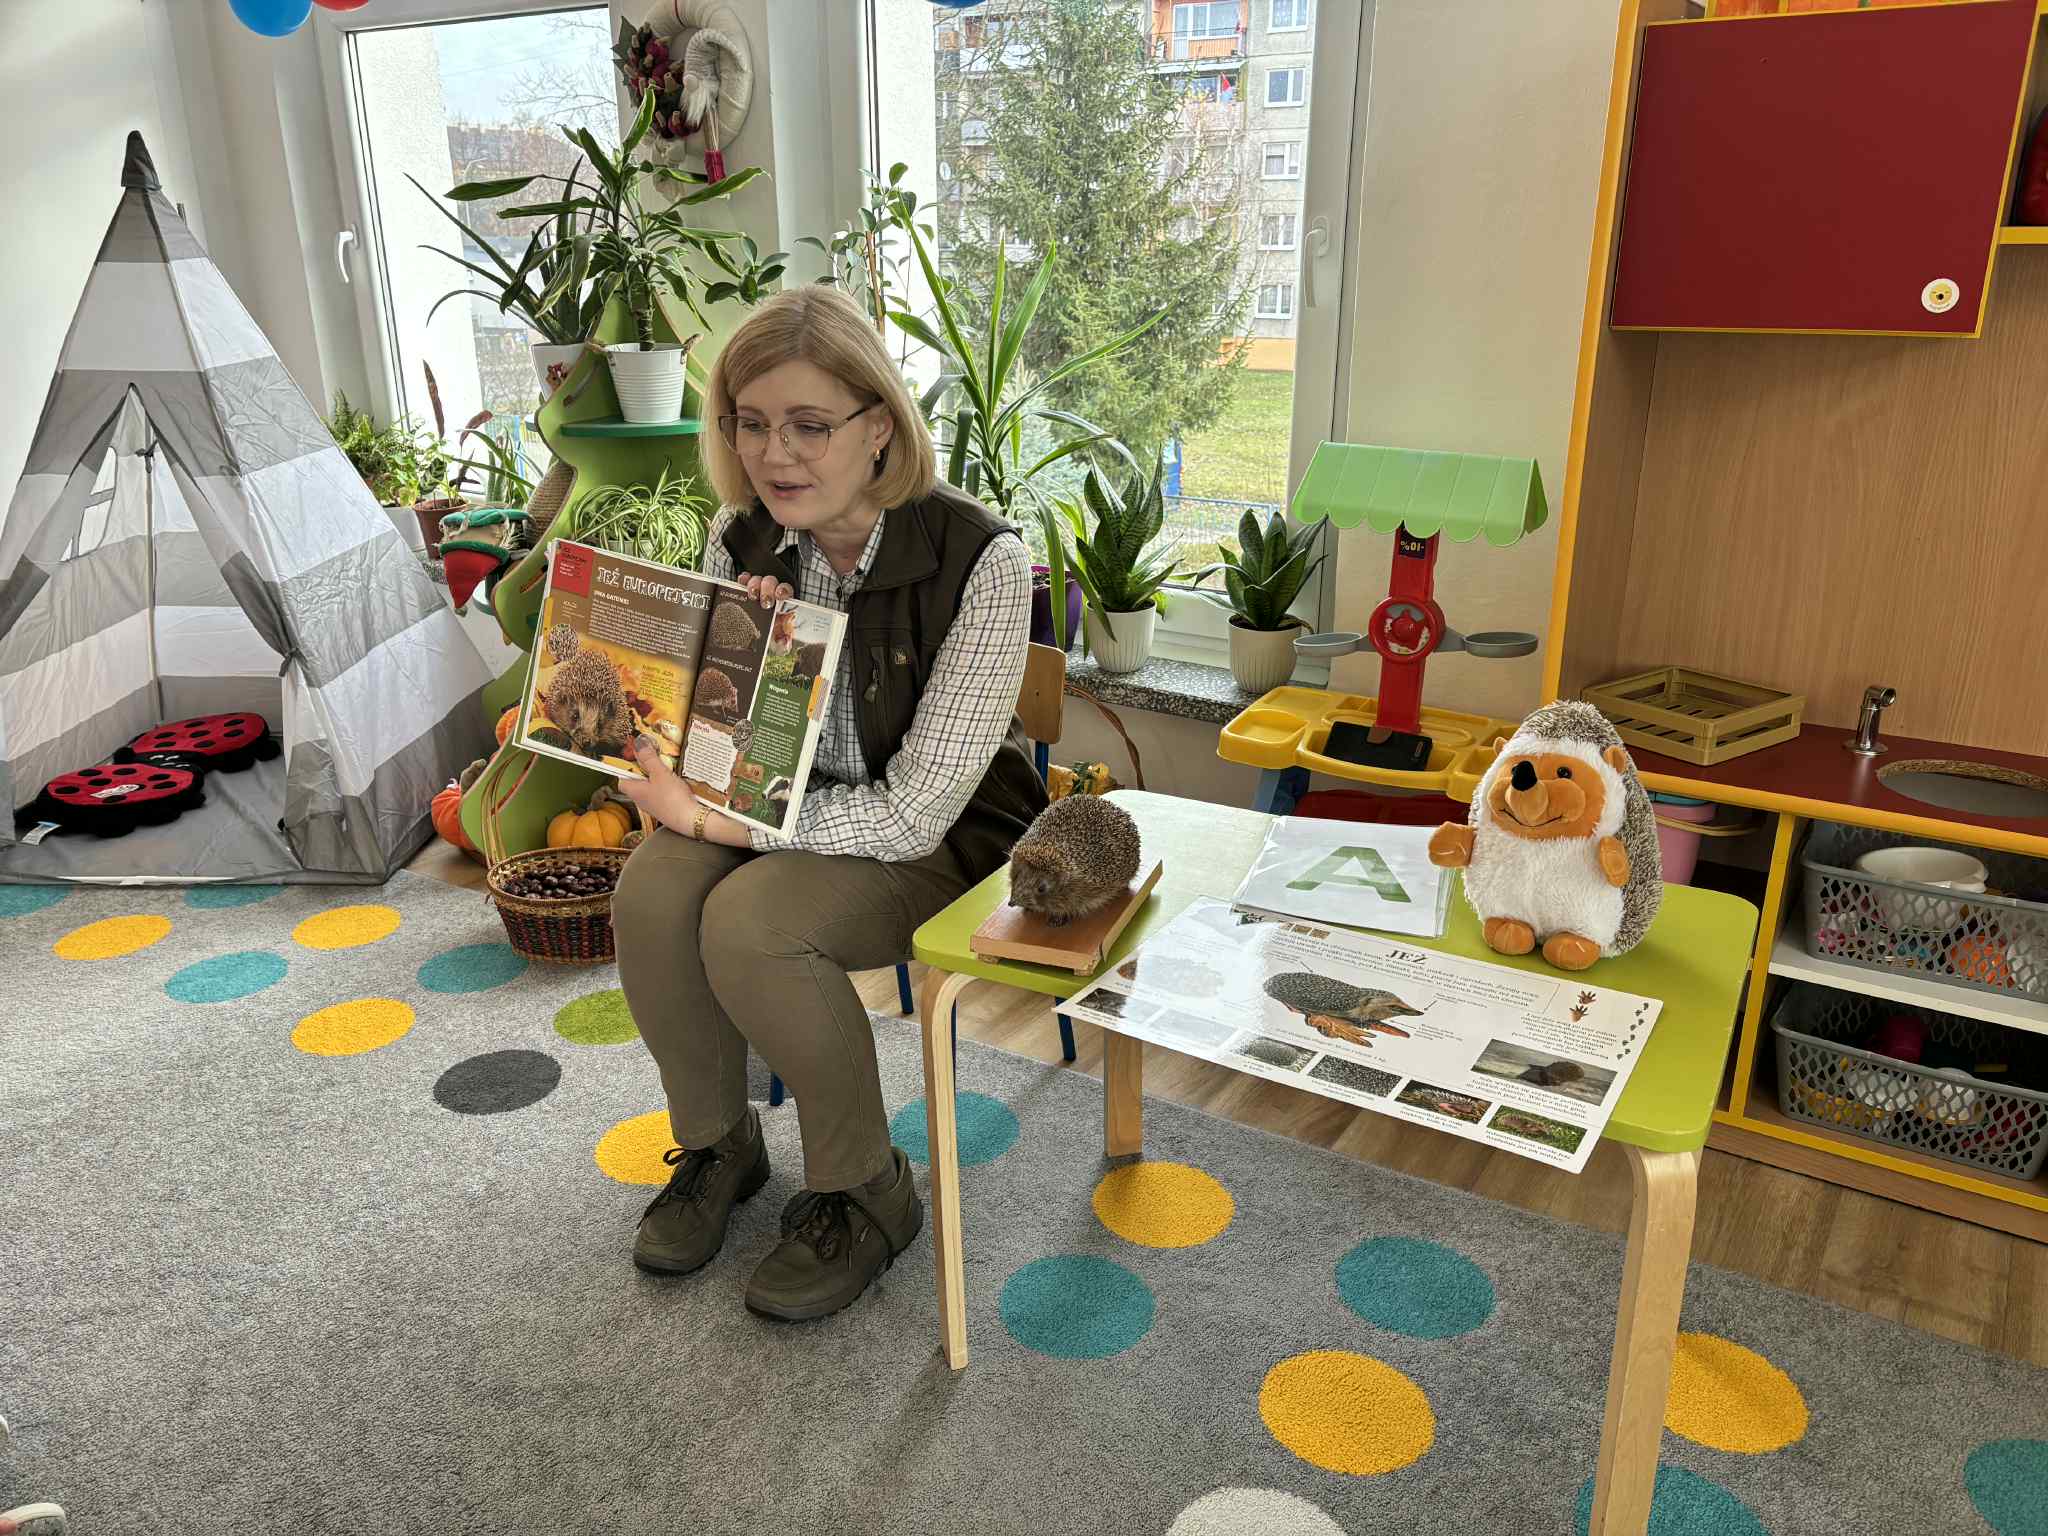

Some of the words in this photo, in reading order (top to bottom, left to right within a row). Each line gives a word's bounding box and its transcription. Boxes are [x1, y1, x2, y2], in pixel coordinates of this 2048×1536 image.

[623, 575, 711, 611] EUROPEJSKI
[1286, 845, 1412, 903] A
[1385, 949, 1428, 965] JEŻ
